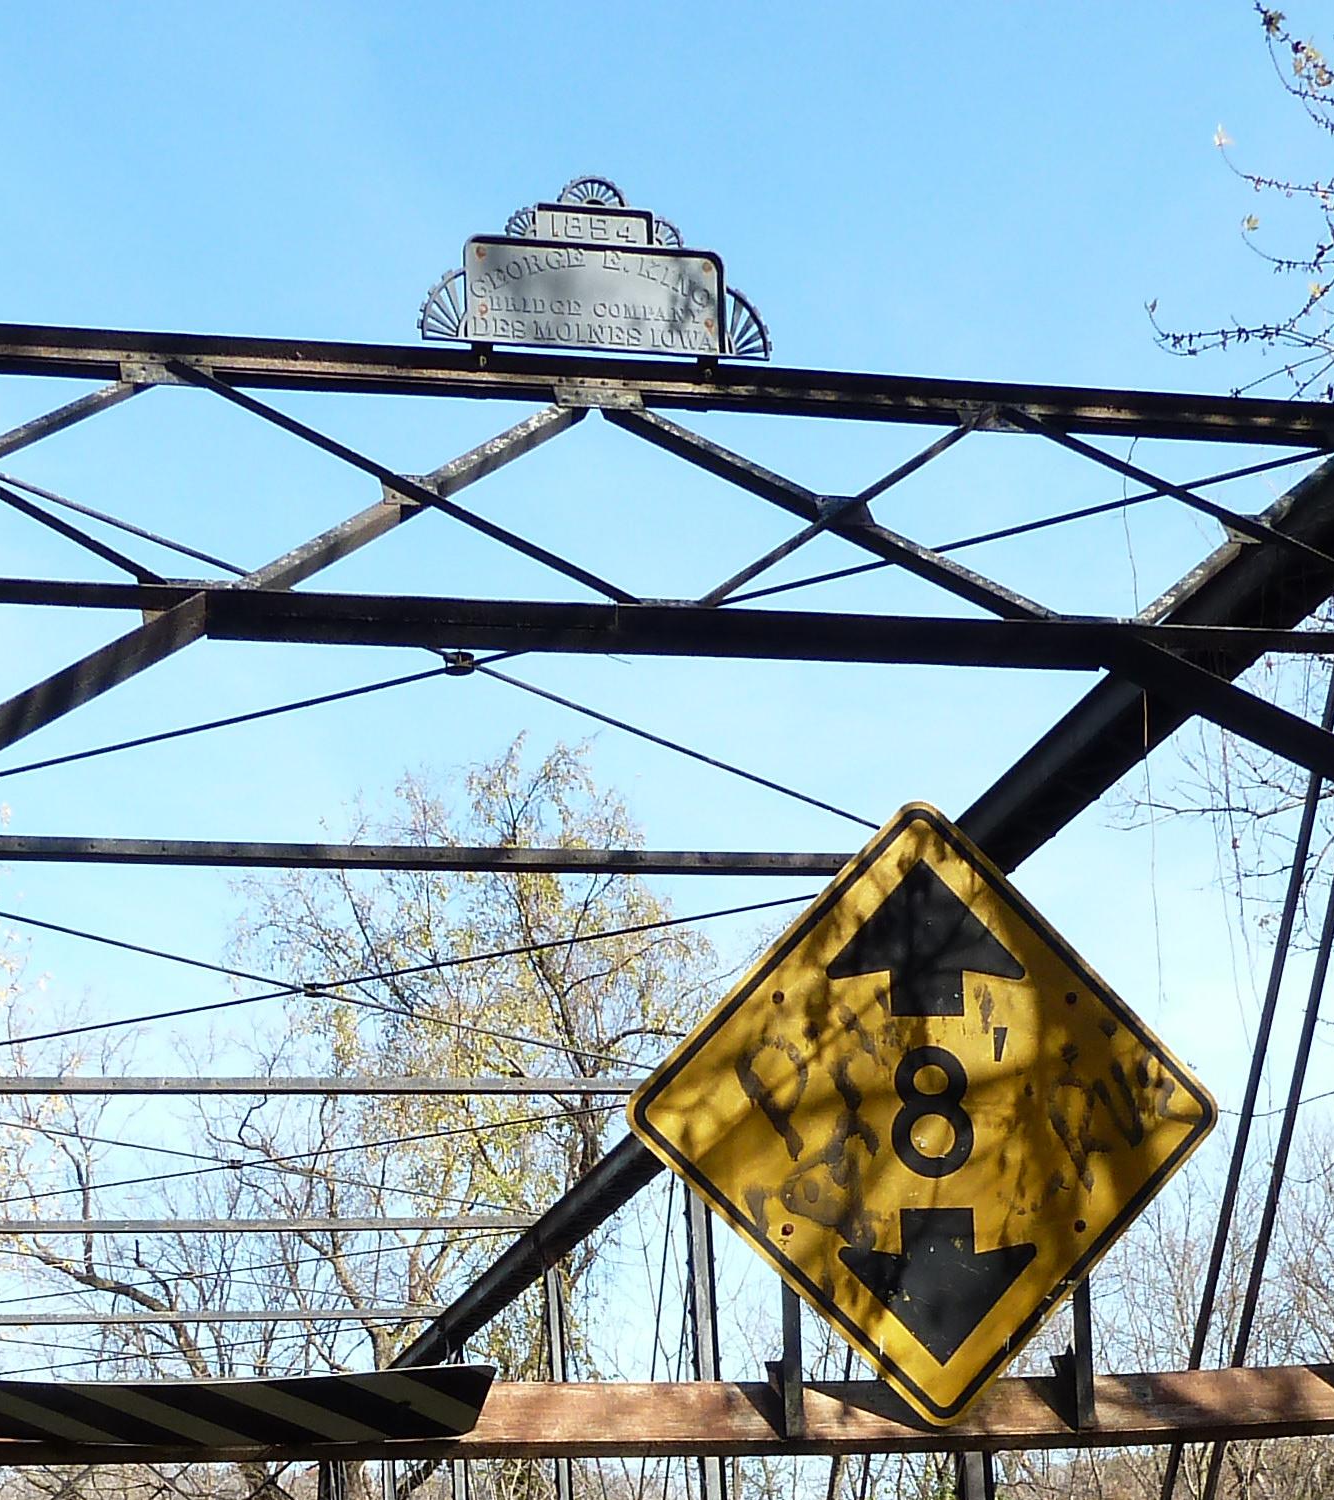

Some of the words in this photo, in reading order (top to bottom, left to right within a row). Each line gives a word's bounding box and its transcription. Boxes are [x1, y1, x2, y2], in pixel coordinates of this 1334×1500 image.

[469, 248, 586, 298] GEORGE
[602, 250, 629, 273] E.
[638, 256, 711, 308] KING
[490, 296, 582, 316] BRIDGE
[593, 302, 702, 324] COMPANY
[473, 317, 526, 339] DES
[533, 320, 643, 346] MOINES
[650, 327, 718, 351] IOWA
